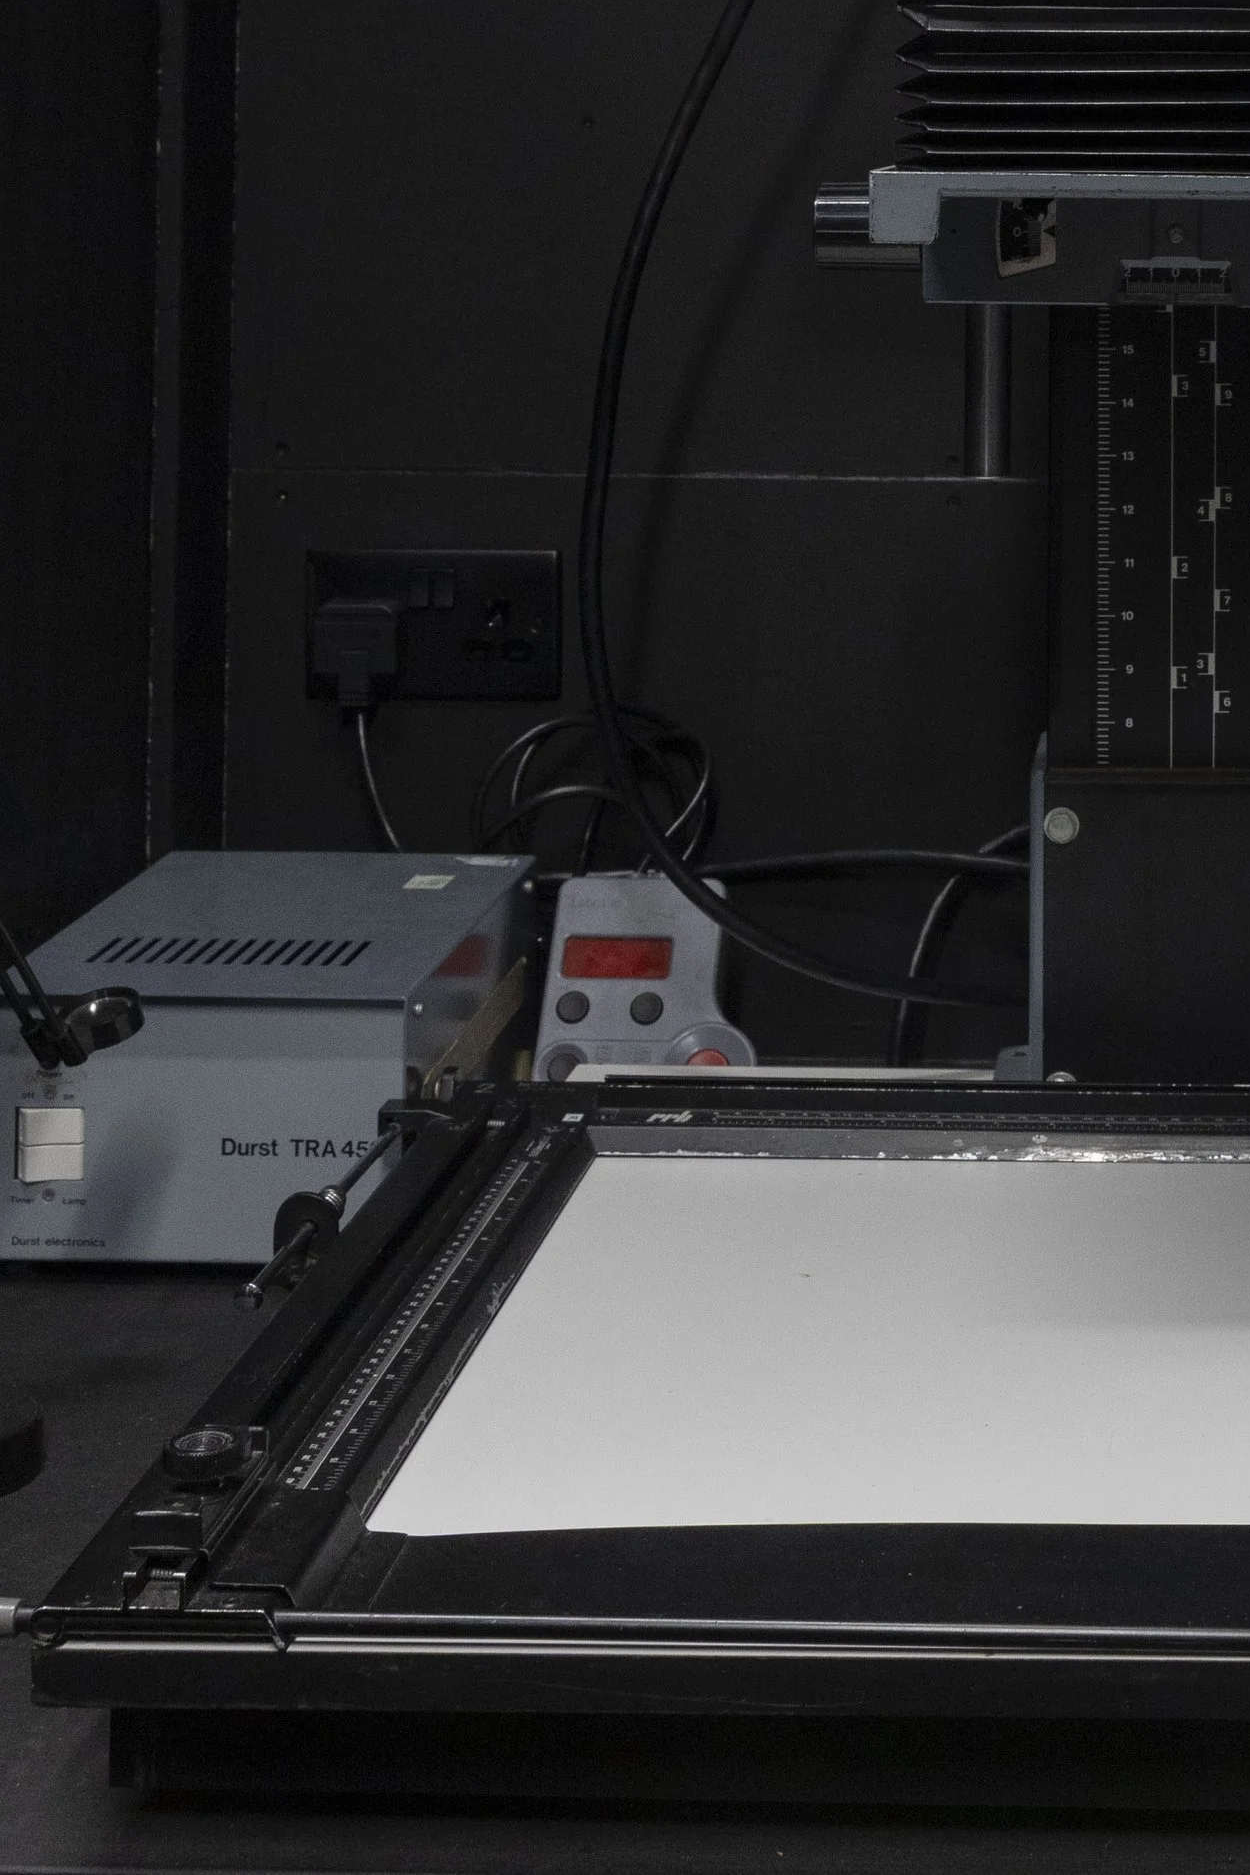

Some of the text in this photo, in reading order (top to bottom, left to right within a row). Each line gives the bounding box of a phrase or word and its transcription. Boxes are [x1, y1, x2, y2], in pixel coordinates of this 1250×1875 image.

[1123, 345, 1134, 354] 15
[1199, 347, 1206, 357] 5
[1182, 381, 1189, 390] 3
[1225, 390, 1232, 399] 9
[1122, 398, 1134, 407] 14
[1122, 451, 1134, 461] 13
[1225, 493, 1232, 502] 8
[1123, 505, 1134, 514] 12
[1198, 506, 1204, 515] 4
[1125, 558, 1134, 567] 11
[1181, 563, 1188, 572] 2
[1224, 596, 1230, 605] 7
[1121, 611, 1134, 620] 10
[1197, 659, 1204, 669] 3
[1126, 664, 1134, 674] 9
[1182, 673, 1186, 682] 1
[1224, 697, 1231, 707] 6
[1125, 718, 1133, 728] 8
[221, 1138, 375, 1158] Durst TRA 45
[11, 1236, 106, 1247] Durst electronics
